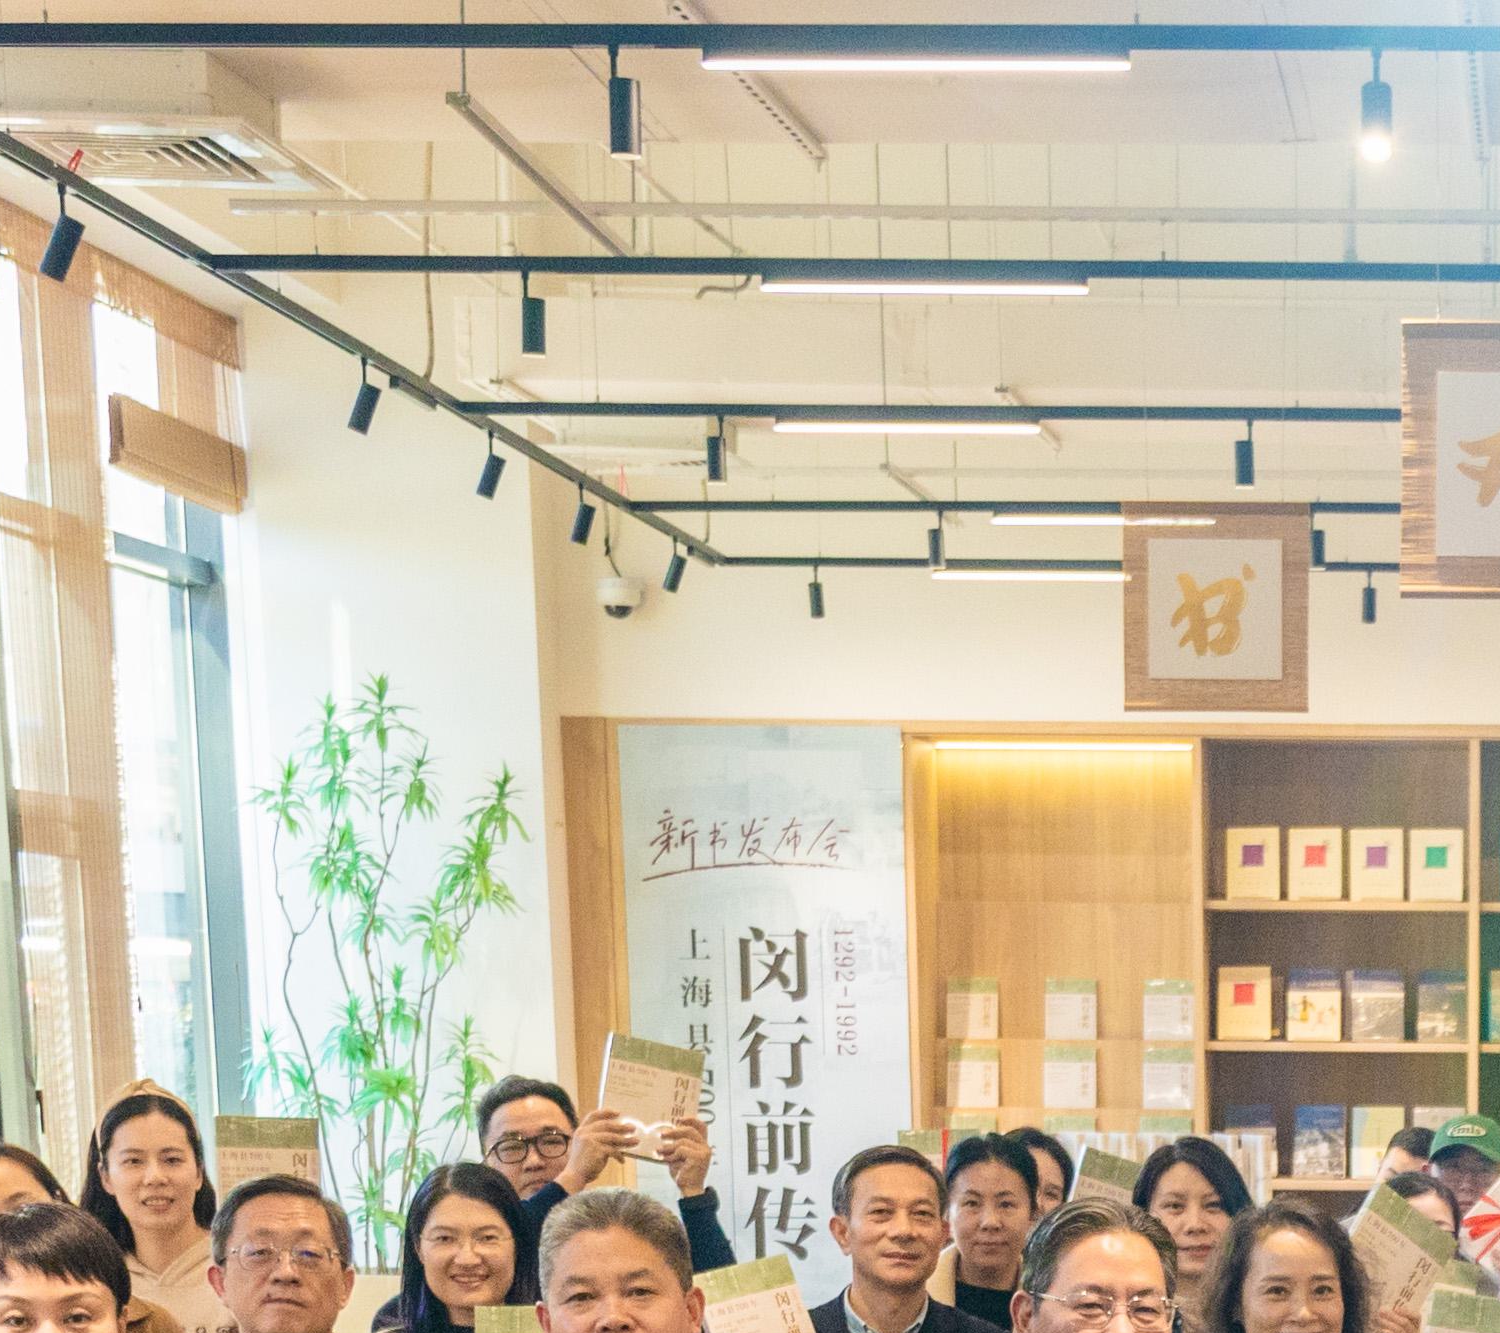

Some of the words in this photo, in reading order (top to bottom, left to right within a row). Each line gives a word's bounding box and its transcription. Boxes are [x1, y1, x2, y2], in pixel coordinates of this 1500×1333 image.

[1171, 565, 1256, 657] 书
[649, 808, 851, 866] 新书发布会
[834, 927, 858, 1057] 1292-1992
[738, 926, 818, 1262] 闵行前传
